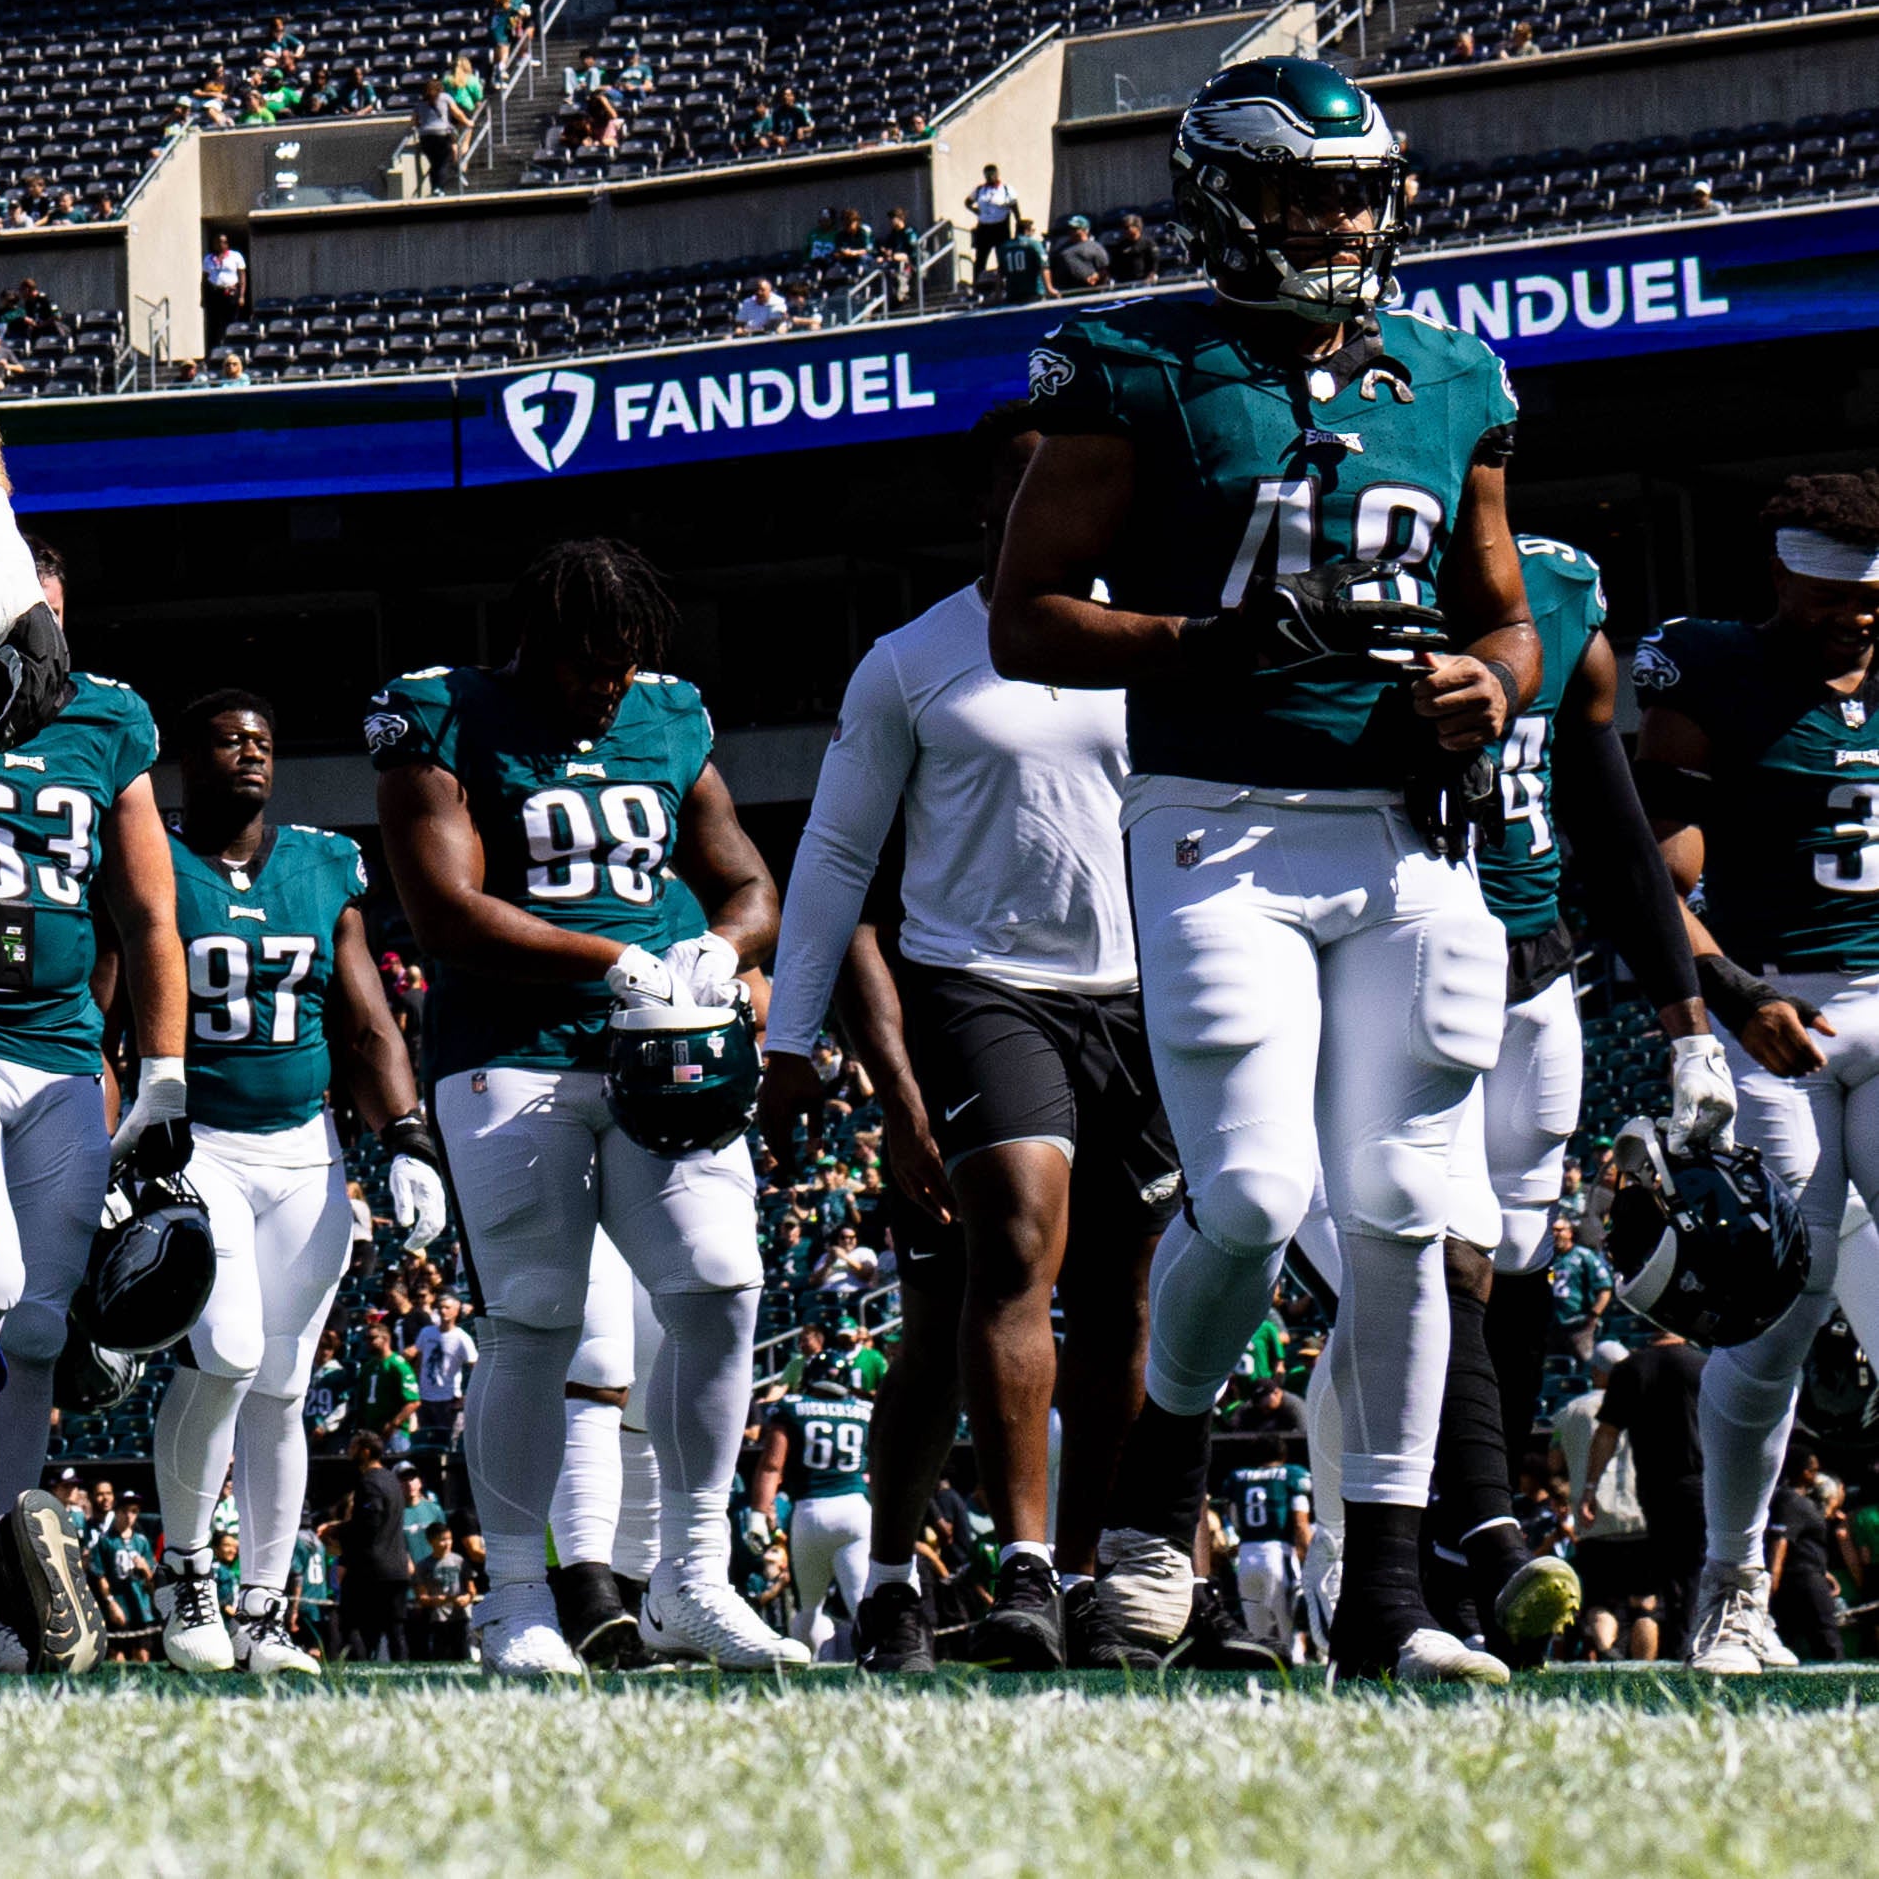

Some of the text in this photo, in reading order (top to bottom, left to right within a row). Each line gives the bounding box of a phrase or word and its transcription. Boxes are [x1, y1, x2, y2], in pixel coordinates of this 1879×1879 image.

[1005, 249, 1026, 273] 10
[1403, 257, 1730, 341] ANDUEL
[614, 352, 936, 442] FANDUEL
[1304, 428, 1364, 453] EAGLES
[1499, 715, 1553, 858] 4
[521, 784, 669, 905] 98
[187, 934, 317, 1042] 97
[802, 1420, 863, 1472] 69
[1245, 1485, 1269, 1528] 8
